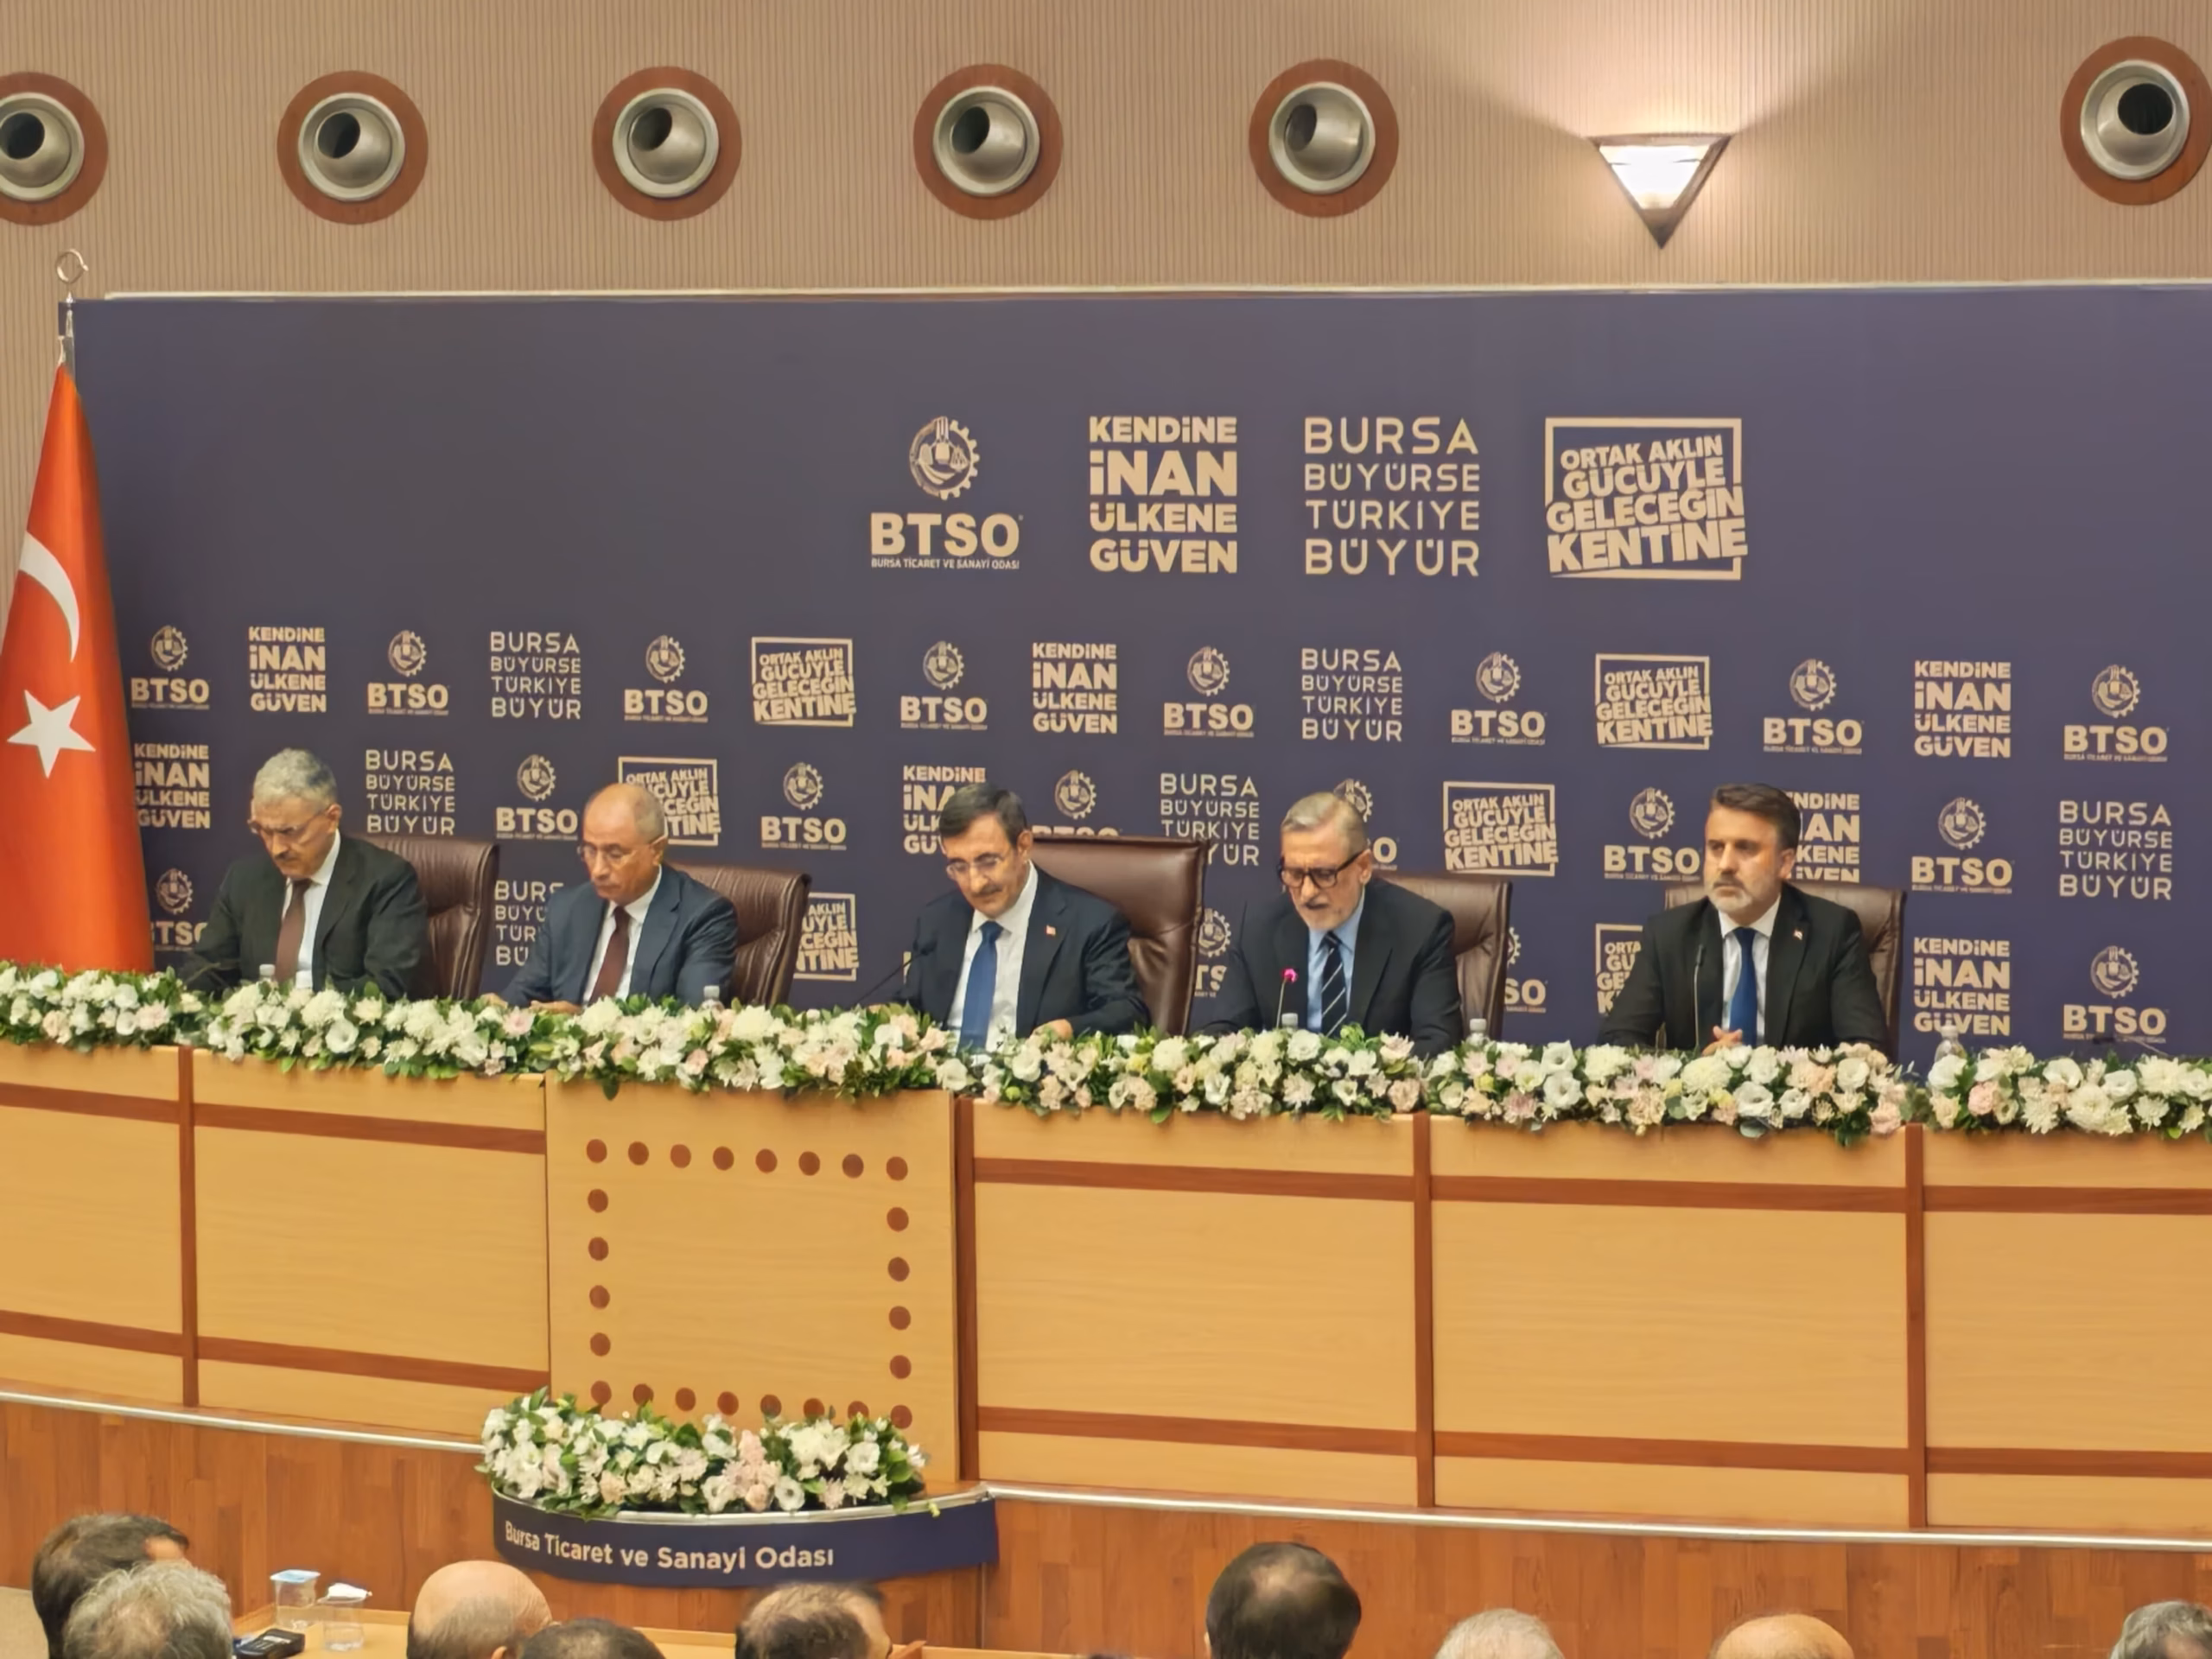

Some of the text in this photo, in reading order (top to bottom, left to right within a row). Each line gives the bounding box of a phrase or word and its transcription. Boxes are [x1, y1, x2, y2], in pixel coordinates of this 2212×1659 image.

[1305, 417, 1478, 454] BURSA
[1560, 434, 1722, 470] ORTAK AKLIN
[1305, 463, 1479, 492] BÜYÜRSE
[1090, 502, 1237, 533] ÜLKENE
[871, 512, 1019, 557] BTSO
[871, 558, 901, 568] BURSA
[944, 559, 954, 569] VE
[992, 560, 1019, 569] ODASI
[1090, 538, 1237, 573] GÜVEN
[1306, 538, 1478, 576] BÜYÜR
[491, 632, 580, 653] BURSA
[491, 656, 581, 673] BÜYÜRSE
[1301, 648, 1402, 671] BURSA
[131, 678, 209, 703] BTSO
[251, 673, 326, 690] ÜLKENE
[1301, 675, 1402, 693] BÜYÜRSE
[251, 693, 326, 712] GÜVEN
[368, 683, 448, 709] BTSO
[492, 697, 581, 719] BÜYÜR
[625, 690, 708, 715] BTSO
[1033, 691, 1116, 710] ÜLKENE
[900, 696, 987, 723] BTSO
[1164, 702, 1253, 730] BTSO
[1033, 712, 1117, 734] GÜVEN
[1302, 718, 1402, 741] BÜYÜR
[1452, 709, 1545, 738] BTSO
[1764, 717, 1862, 747] BTSO
[1915, 714, 2011, 734] ÜLKENE
[1915, 735, 2011, 758] GÜVEN
[2064, 725, 2167, 754] BTSO
[365, 749, 454, 772] BURSA
[366, 774, 454, 792] BÜYÜRSE
[1160, 773, 1258, 797] BURSA
[139, 810, 210, 829] GÜVEN
[496, 807, 577, 834] BTSO
[1160, 799, 1259, 818] BÜYÜRSE
[2060, 800, 2171, 826] BURSA
[367, 815, 454, 836] BÜYÜR
[761, 817, 846, 843] BTSO
[903, 814, 940, 832] ÜLK
[1800, 813, 1859, 842] AN
[2060, 828, 2172, 849] BÜYÜRSE
[1208, 843, 1259, 866] YÜR
[1605, 845, 1700, 874] BTSO
[1796, 844, 1859, 864] KENE
[1912, 856, 2012, 887] BTSO
[2060, 874, 2171, 900] BÜYÜR
[495, 905, 547, 922] BÜYÜ
[1605, 941, 1641, 954] ORTA
[1504, 977, 1546, 1006] SO
[1914, 989, 2010, 1012] ÜLKENE
[2063, 1004, 2166, 1035] BTSO
[505, 1522, 833, 1573] Bursa Ticaret ve Sanayi Odası
